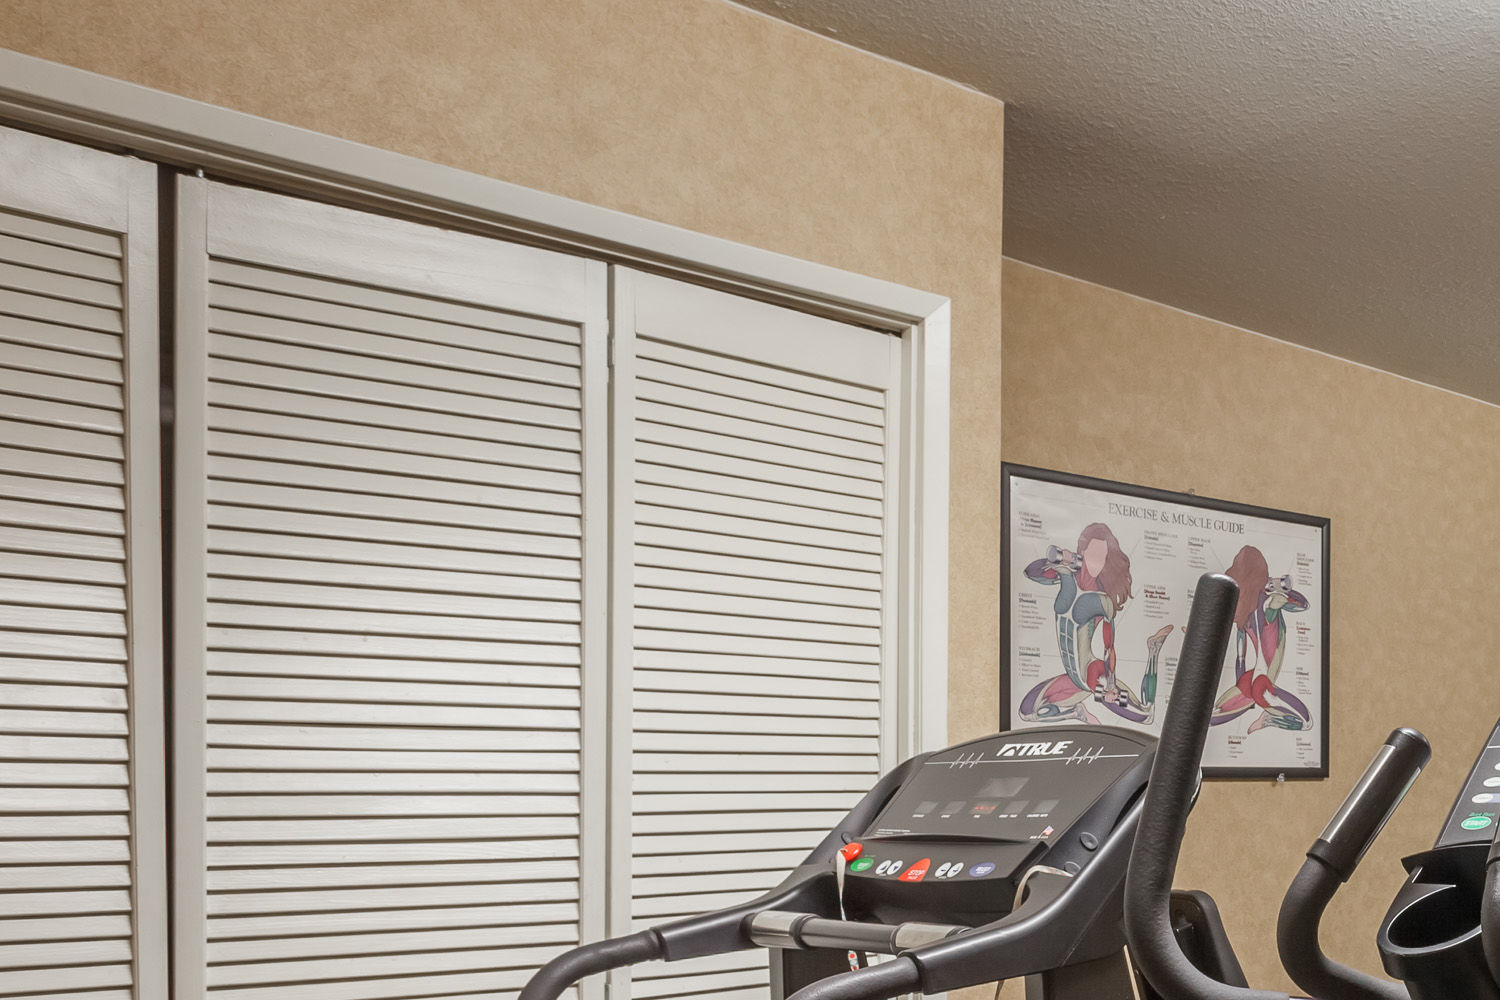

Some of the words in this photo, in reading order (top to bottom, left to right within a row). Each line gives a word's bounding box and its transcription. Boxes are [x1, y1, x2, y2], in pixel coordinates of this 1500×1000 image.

[1108, 502, 1158, 521] EXERCISE
[1160, 511, 1170, 524] &
[1172, 513, 1212, 530] MUSCLE
[1213, 520, 1245, 535] GUIDE
[1018, 740, 1074, 757] TRUE
